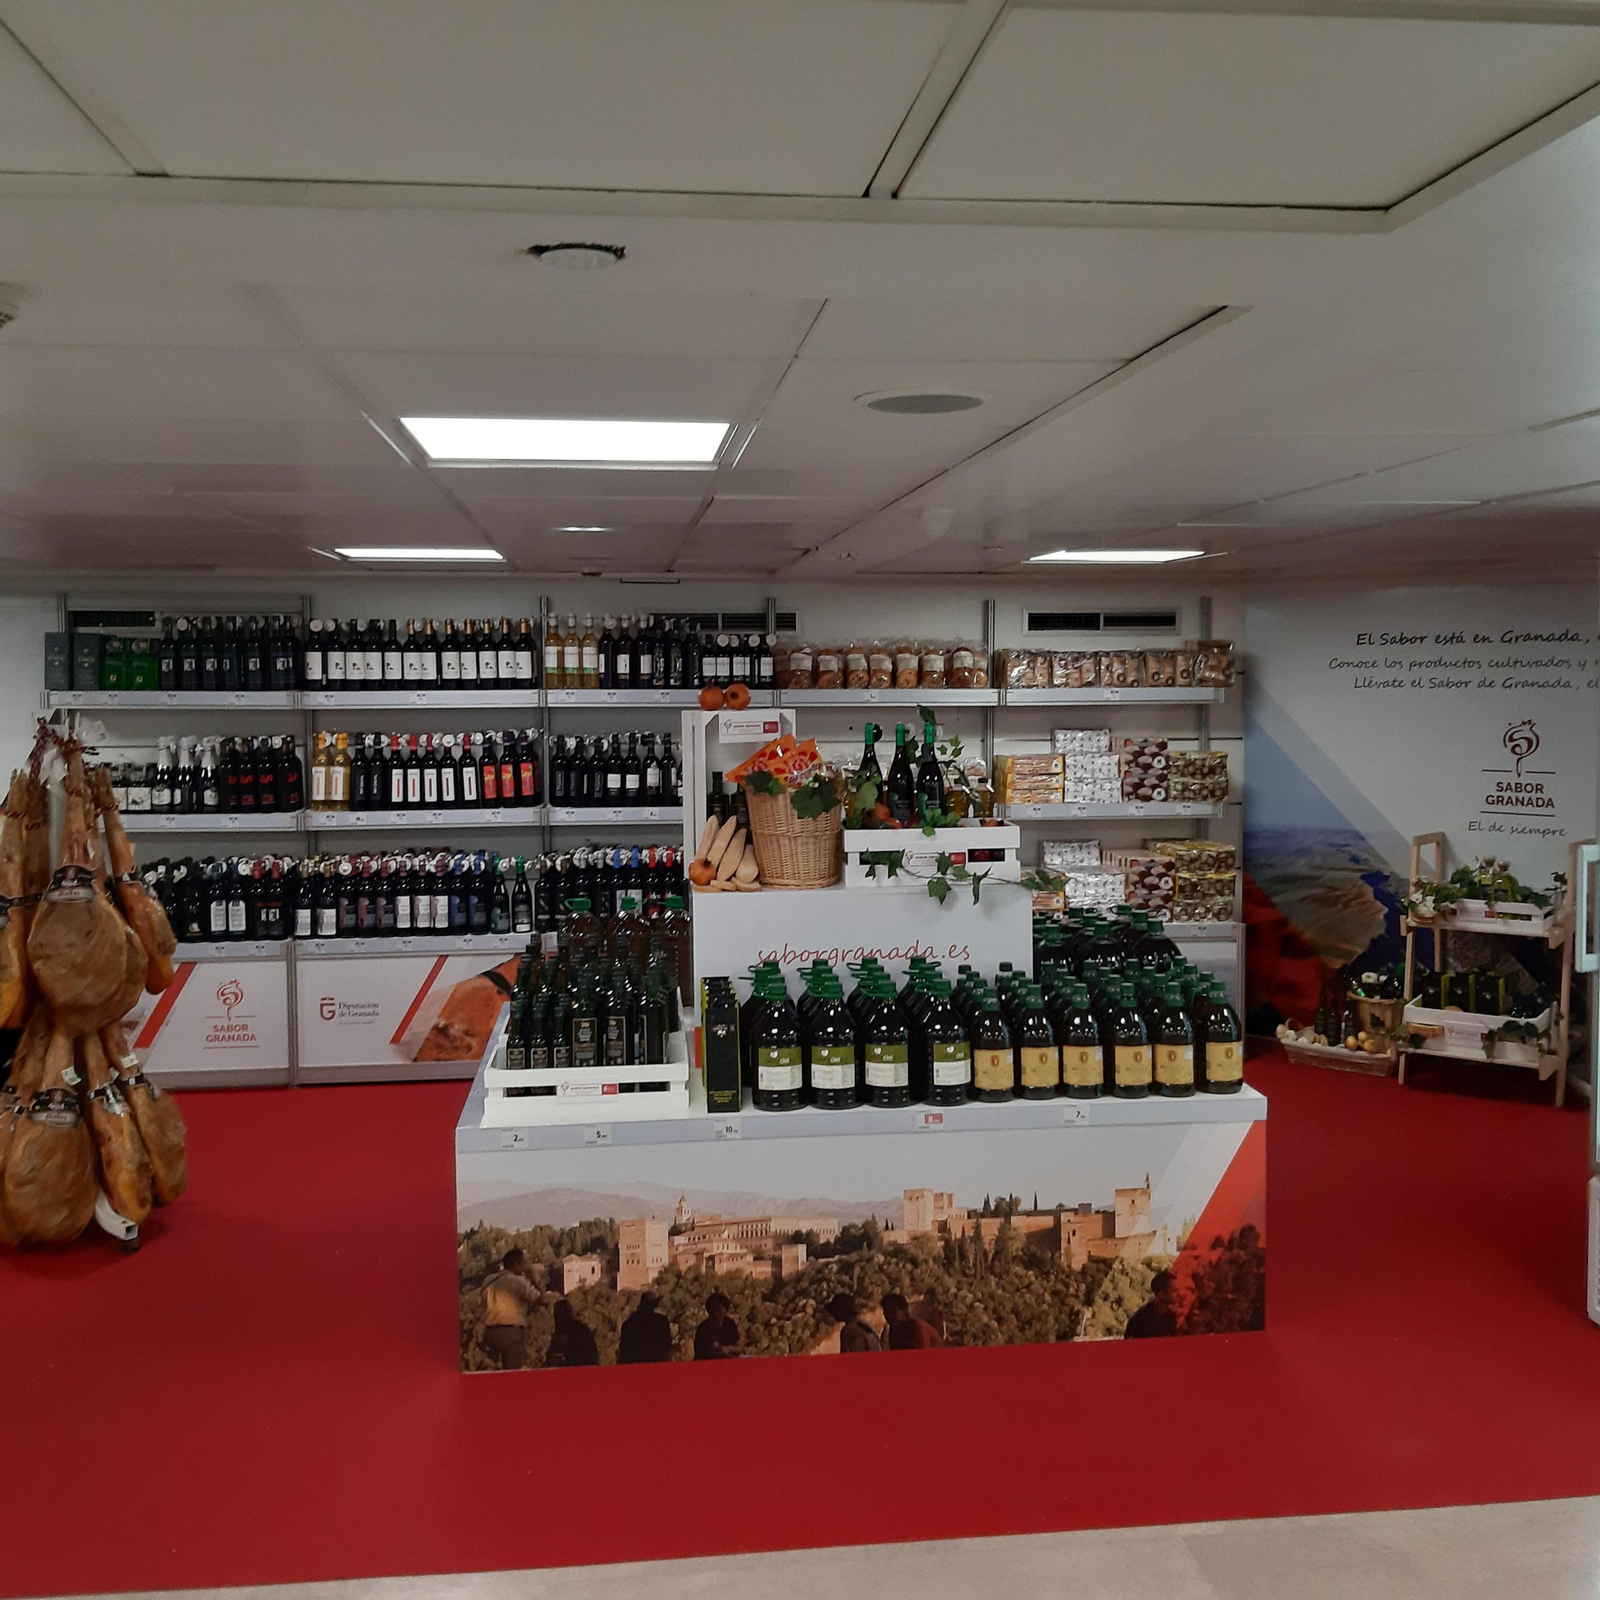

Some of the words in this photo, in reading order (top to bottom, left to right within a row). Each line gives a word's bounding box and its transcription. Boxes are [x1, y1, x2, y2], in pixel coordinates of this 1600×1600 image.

[1355, 632, 1376, 646] El
[1379, 631, 1428, 646] Sabor
[1434, 630, 1467, 646] está
[1473, 633, 1494, 644] en
[1328, 657, 1379, 670] Conoce
[1384, 656, 1404, 670] los
[1407, 655, 1482, 672] productos
[1488, 655, 1572, 669] cultivados
[1578, 659, 1588, 672] y
[1353, 675, 1406, 689] Llévate
[1410, 677, 1425, 689] el
[1428, 677, 1473, 690] Sabor
[1477, 676, 1497, 689] de
[1495, 781, 1545, 795] SABOR
[1485, 794, 1556, 809] GRANADA
[1467, 820, 1485, 832] El
[1487, 821, 1507, 834] de
[1509, 823, 1568, 839] siempre
[756, 939, 971, 969] saborgranada.es
[338, 1001, 379, 1010] Diputación
[348, 1009, 380, 1018] Granada
[212, 1023, 249, 1033] SABOR
[205, 1033, 257, 1042] GRANADA
